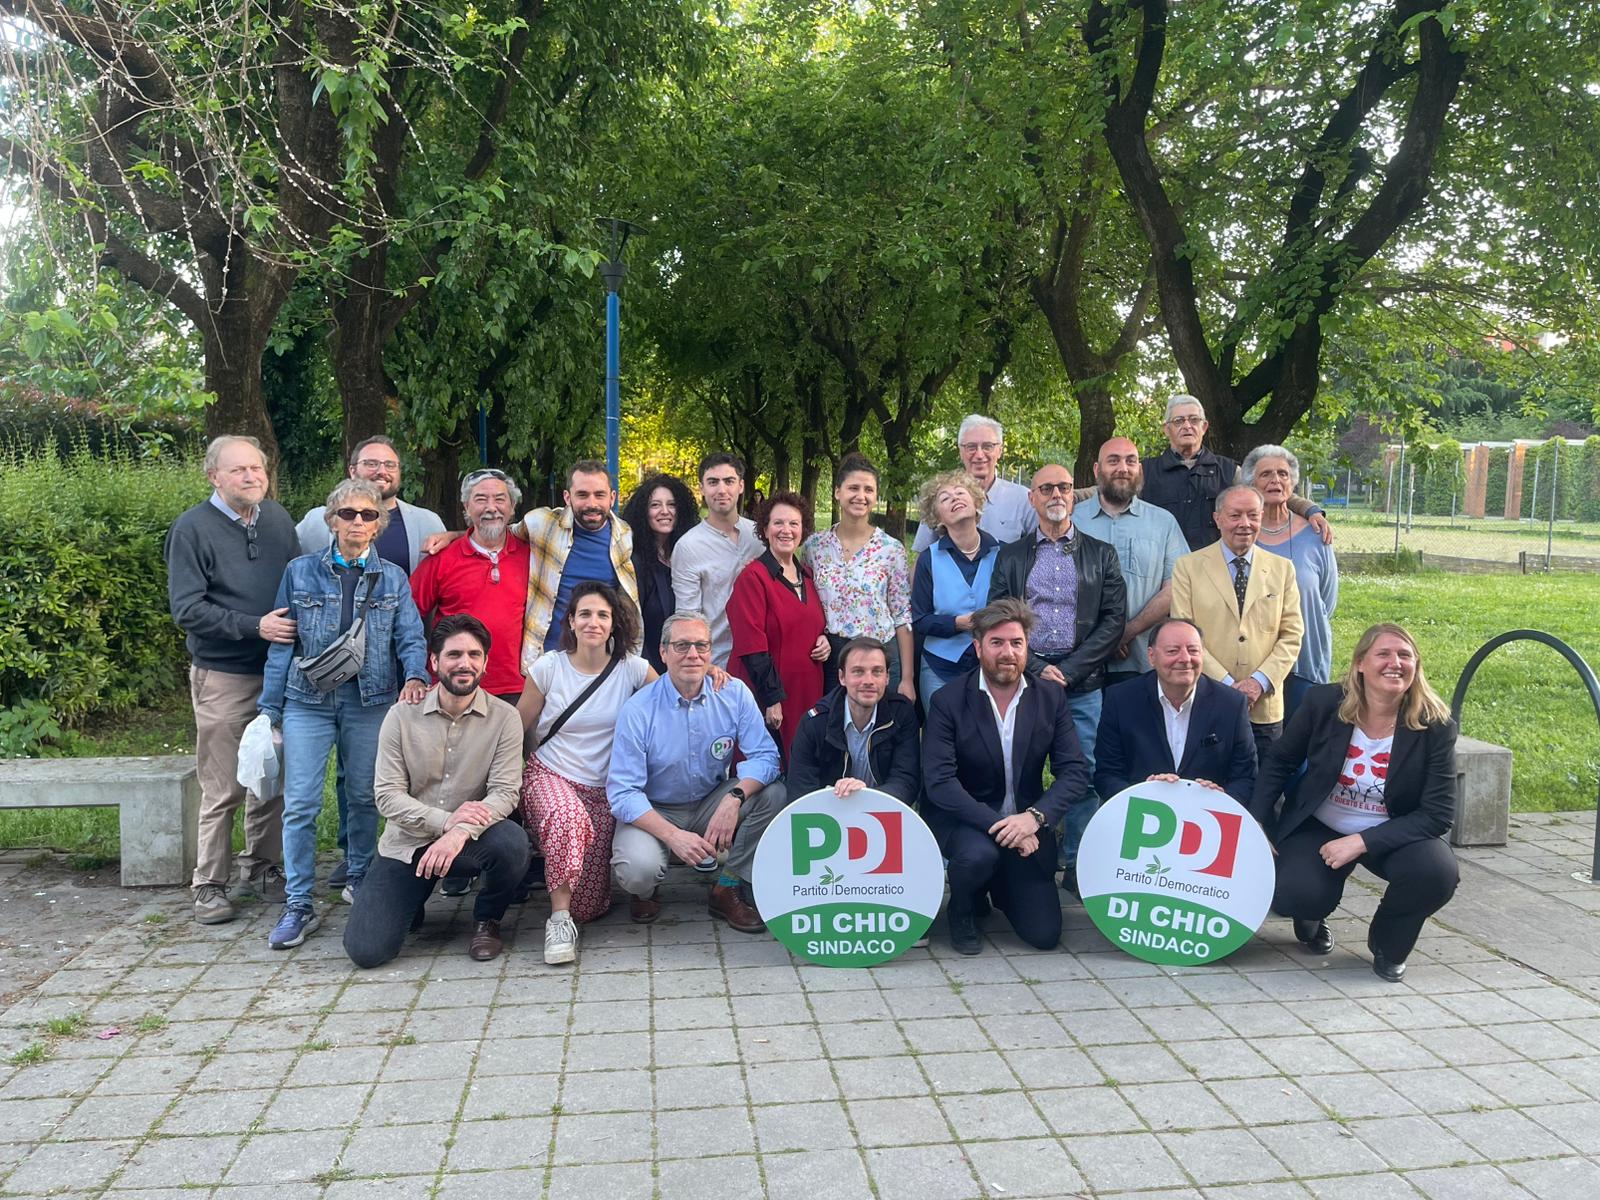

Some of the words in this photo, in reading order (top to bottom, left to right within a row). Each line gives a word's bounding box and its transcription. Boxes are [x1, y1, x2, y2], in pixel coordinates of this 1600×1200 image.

[1335, 796, 1358, 808] QUESTO
[791, 812, 903, 875] PD
[1120, 796, 1242, 878] PD
[793, 885, 828, 896] Partito
[835, 884, 904, 895] Democratico
[1116, 868, 1152, 884] Partito
[1158, 876, 1230, 899] Democratico
[792, 914, 821, 934] DI
[832, 912, 910, 933] CHIO
[1108, 897, 1139, 921] DI
[1150, 906, 1230, 938] CHIO
[807, 940, 896, 955] SINDACO
[1119, 928, 1210, 958] SINDACO
